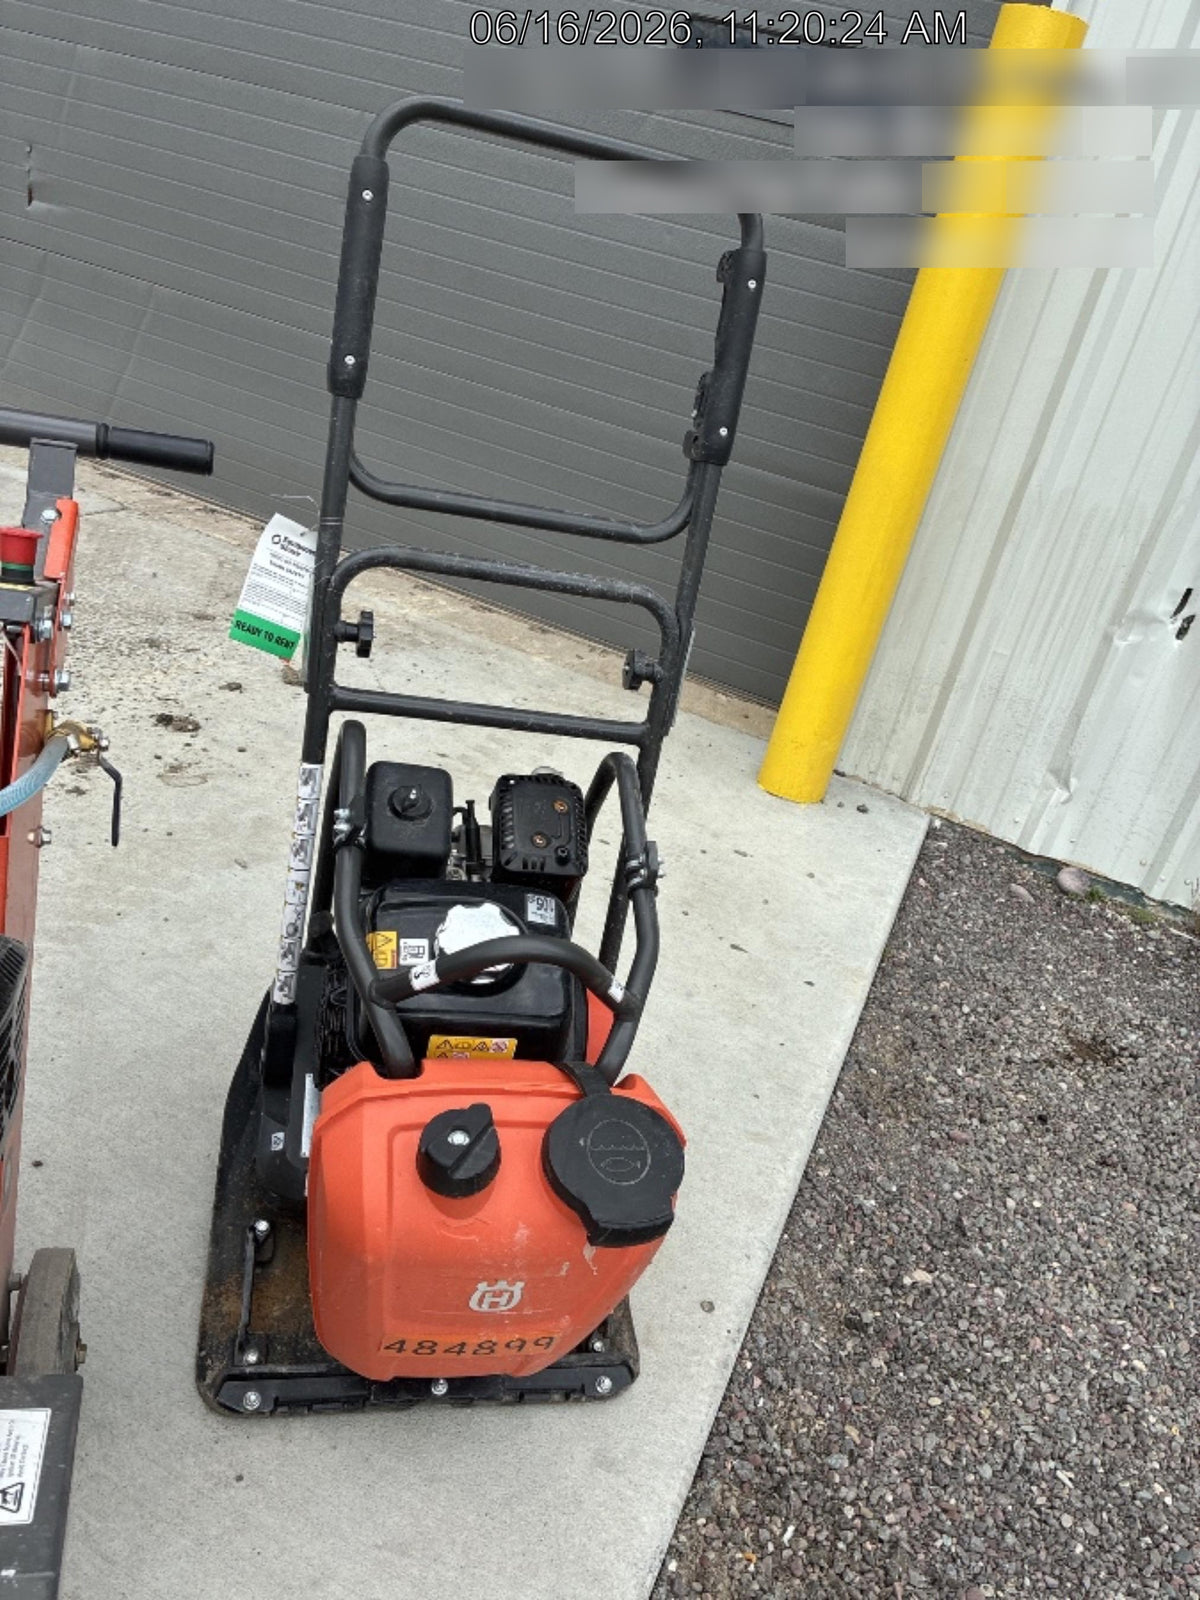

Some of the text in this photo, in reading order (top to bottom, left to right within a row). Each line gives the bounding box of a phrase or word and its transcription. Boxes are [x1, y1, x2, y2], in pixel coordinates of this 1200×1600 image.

[234, 620, 296, 650] READY TO RENT
[383, 1336, 554, 1356] 484899
